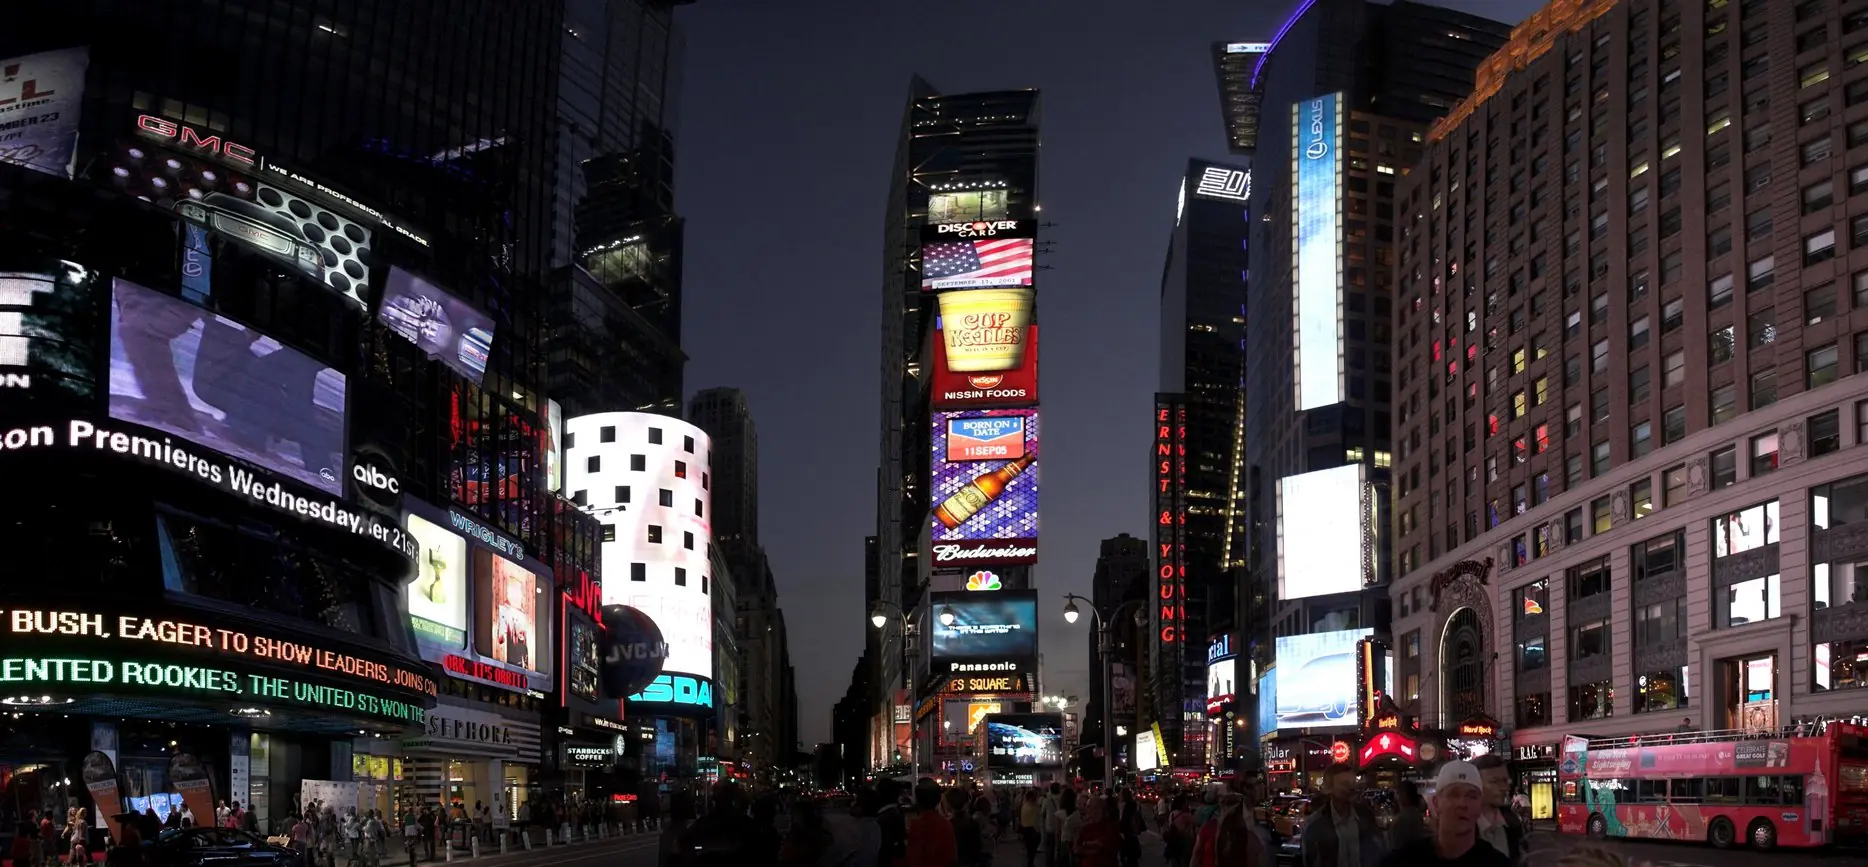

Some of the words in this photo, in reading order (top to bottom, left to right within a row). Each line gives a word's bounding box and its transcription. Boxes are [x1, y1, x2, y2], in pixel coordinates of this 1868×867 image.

[41, 112, 60, 123] 23
[1312, 100, 1323, 143] LEXUS
[137, 113, 256, 165] GMC
[268, 163, 288, 176] WE
[290, 173, 315, 187] ARE
[317, 183, 394, 230] PROFESSIONAL
[395, 225, 430, 248] GRADE.
[937, 221, 1017, 233] DISCOVER
[958, 229, 996, 237] CARD
[960, 312, 1011, 330] CUP
[944, 390, 983, 400] NISSIN
[986, 389, 1026, 398] FOODS
[963, 421, 992, 430] BORN
[994, 420, 1010, 428] ON
[973, 428, 1001, 436] DATE
[964, 446, 1008, 456] 11SEP05
[1158, 408, 1170, 492] ERNST
[0, 426, 54, 450] on
[69, 420, 222, 483] Premieres
[228, 464, 364, 535] Wednesday,
[352, 463, 400, 495] abc
[1159, 511, 1172, 525] &
[449, 510, 525, 562] WRIGLEY'S
[932, 544, 1037, 561] Budweiser
[1160, 544, 1175, 642] YOUNG
[11, 610, 110, 638] BUSH,
[119, 616, 213, 648] EAGER
[217, 628, 249, 653] TO
[254, 637, 312, 664] SHOW
[316, 649, 391, 684] LEADERIS,
[394, 668, 423, 691] JOINS
[605, 642, 648, 673] JVC
[950, 661, 1017, 671] Panasonic
[122, 661, 243, 694] ROOKIES,
[248, 673, 290, 699] THE
[294, 681, 354, 709] UNITED
[380, 698, 408, 720] WON
[969, 677, 1012, 691] SQUARE.
[428, 715, 511, 745] SEPHORA
[1463, 725, 1478, 734] Hard
[1479, 726, 1492, 735] Rock
[1226, 720, 1234, 758] REUTERS
[1735, 745, 1766, 754] CELEBRATE
[1592, 760, 1631, 770] Sightseeing
